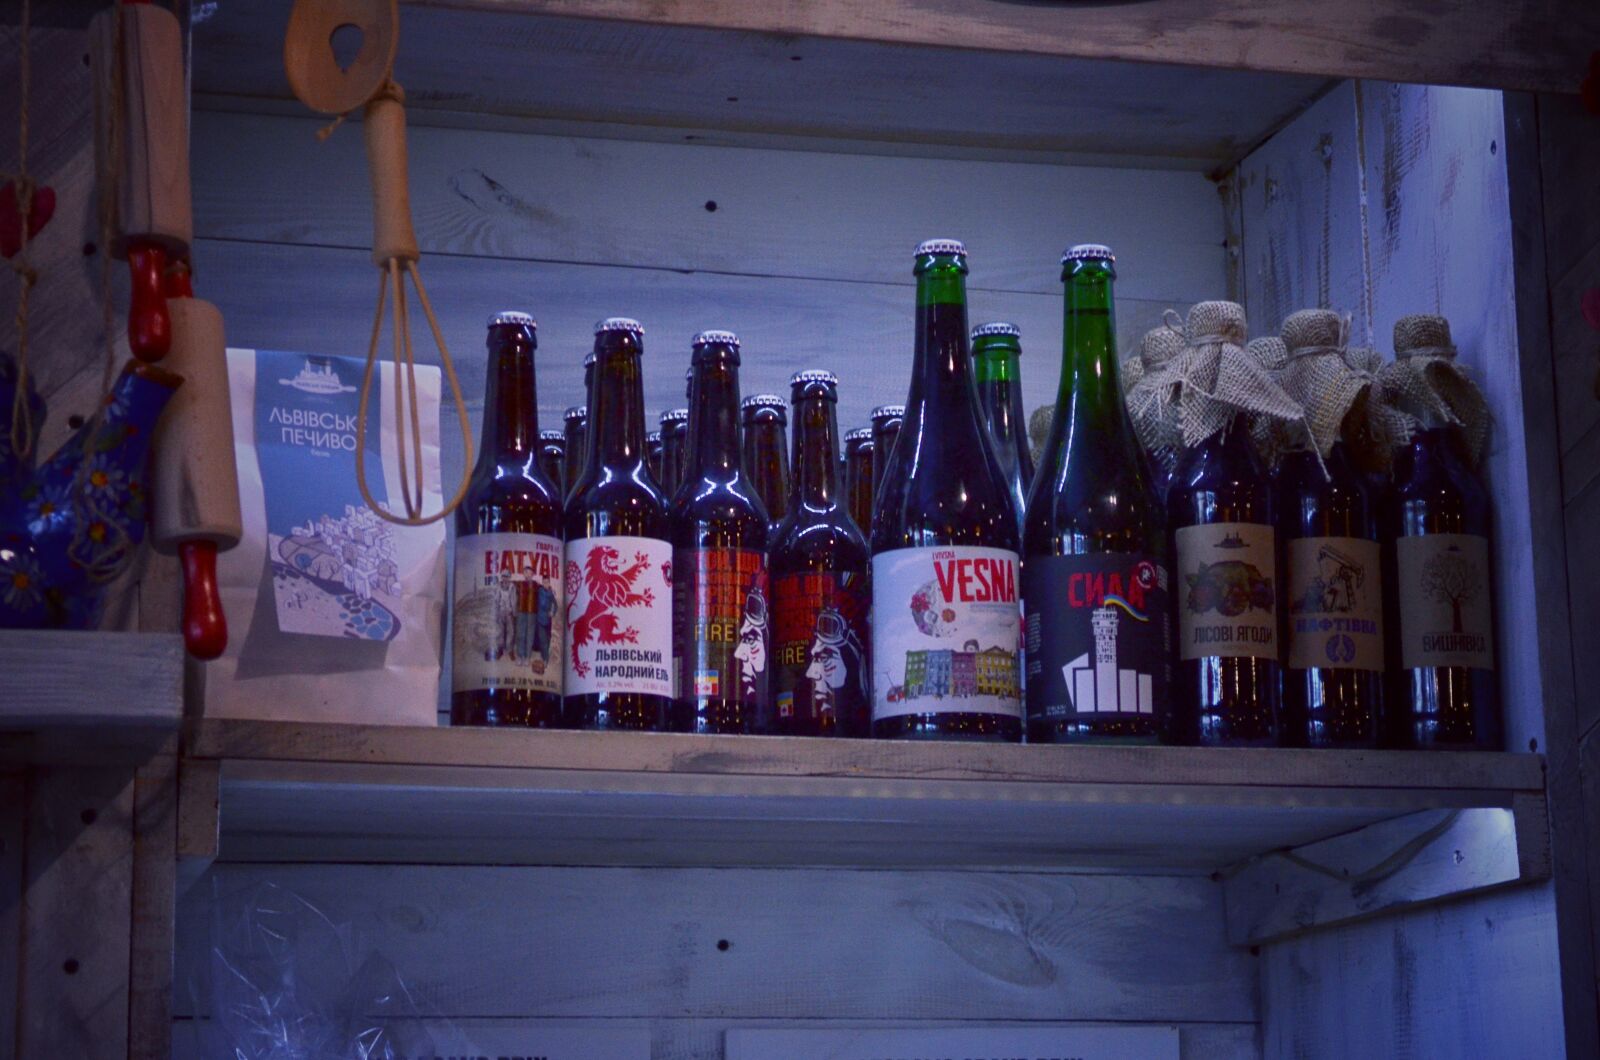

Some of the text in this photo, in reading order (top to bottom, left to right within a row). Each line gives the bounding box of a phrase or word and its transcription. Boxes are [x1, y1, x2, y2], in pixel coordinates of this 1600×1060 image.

[281, 427, 357, 451] ПЕЧИВО
[485, 550, 559, 579] BATYAR
[933, 558, 1016, 603] VESNA
[694, 623, 735, 642] FIRE
[1194, 624, 1273, 644] ЛІСОВІ ЯГОДИ
[595, 648, 662, 663] ЛЬВІВСЬКИЙ
[595, 665, 669, 681] НАРОДНИЙ ЕЛЬ
